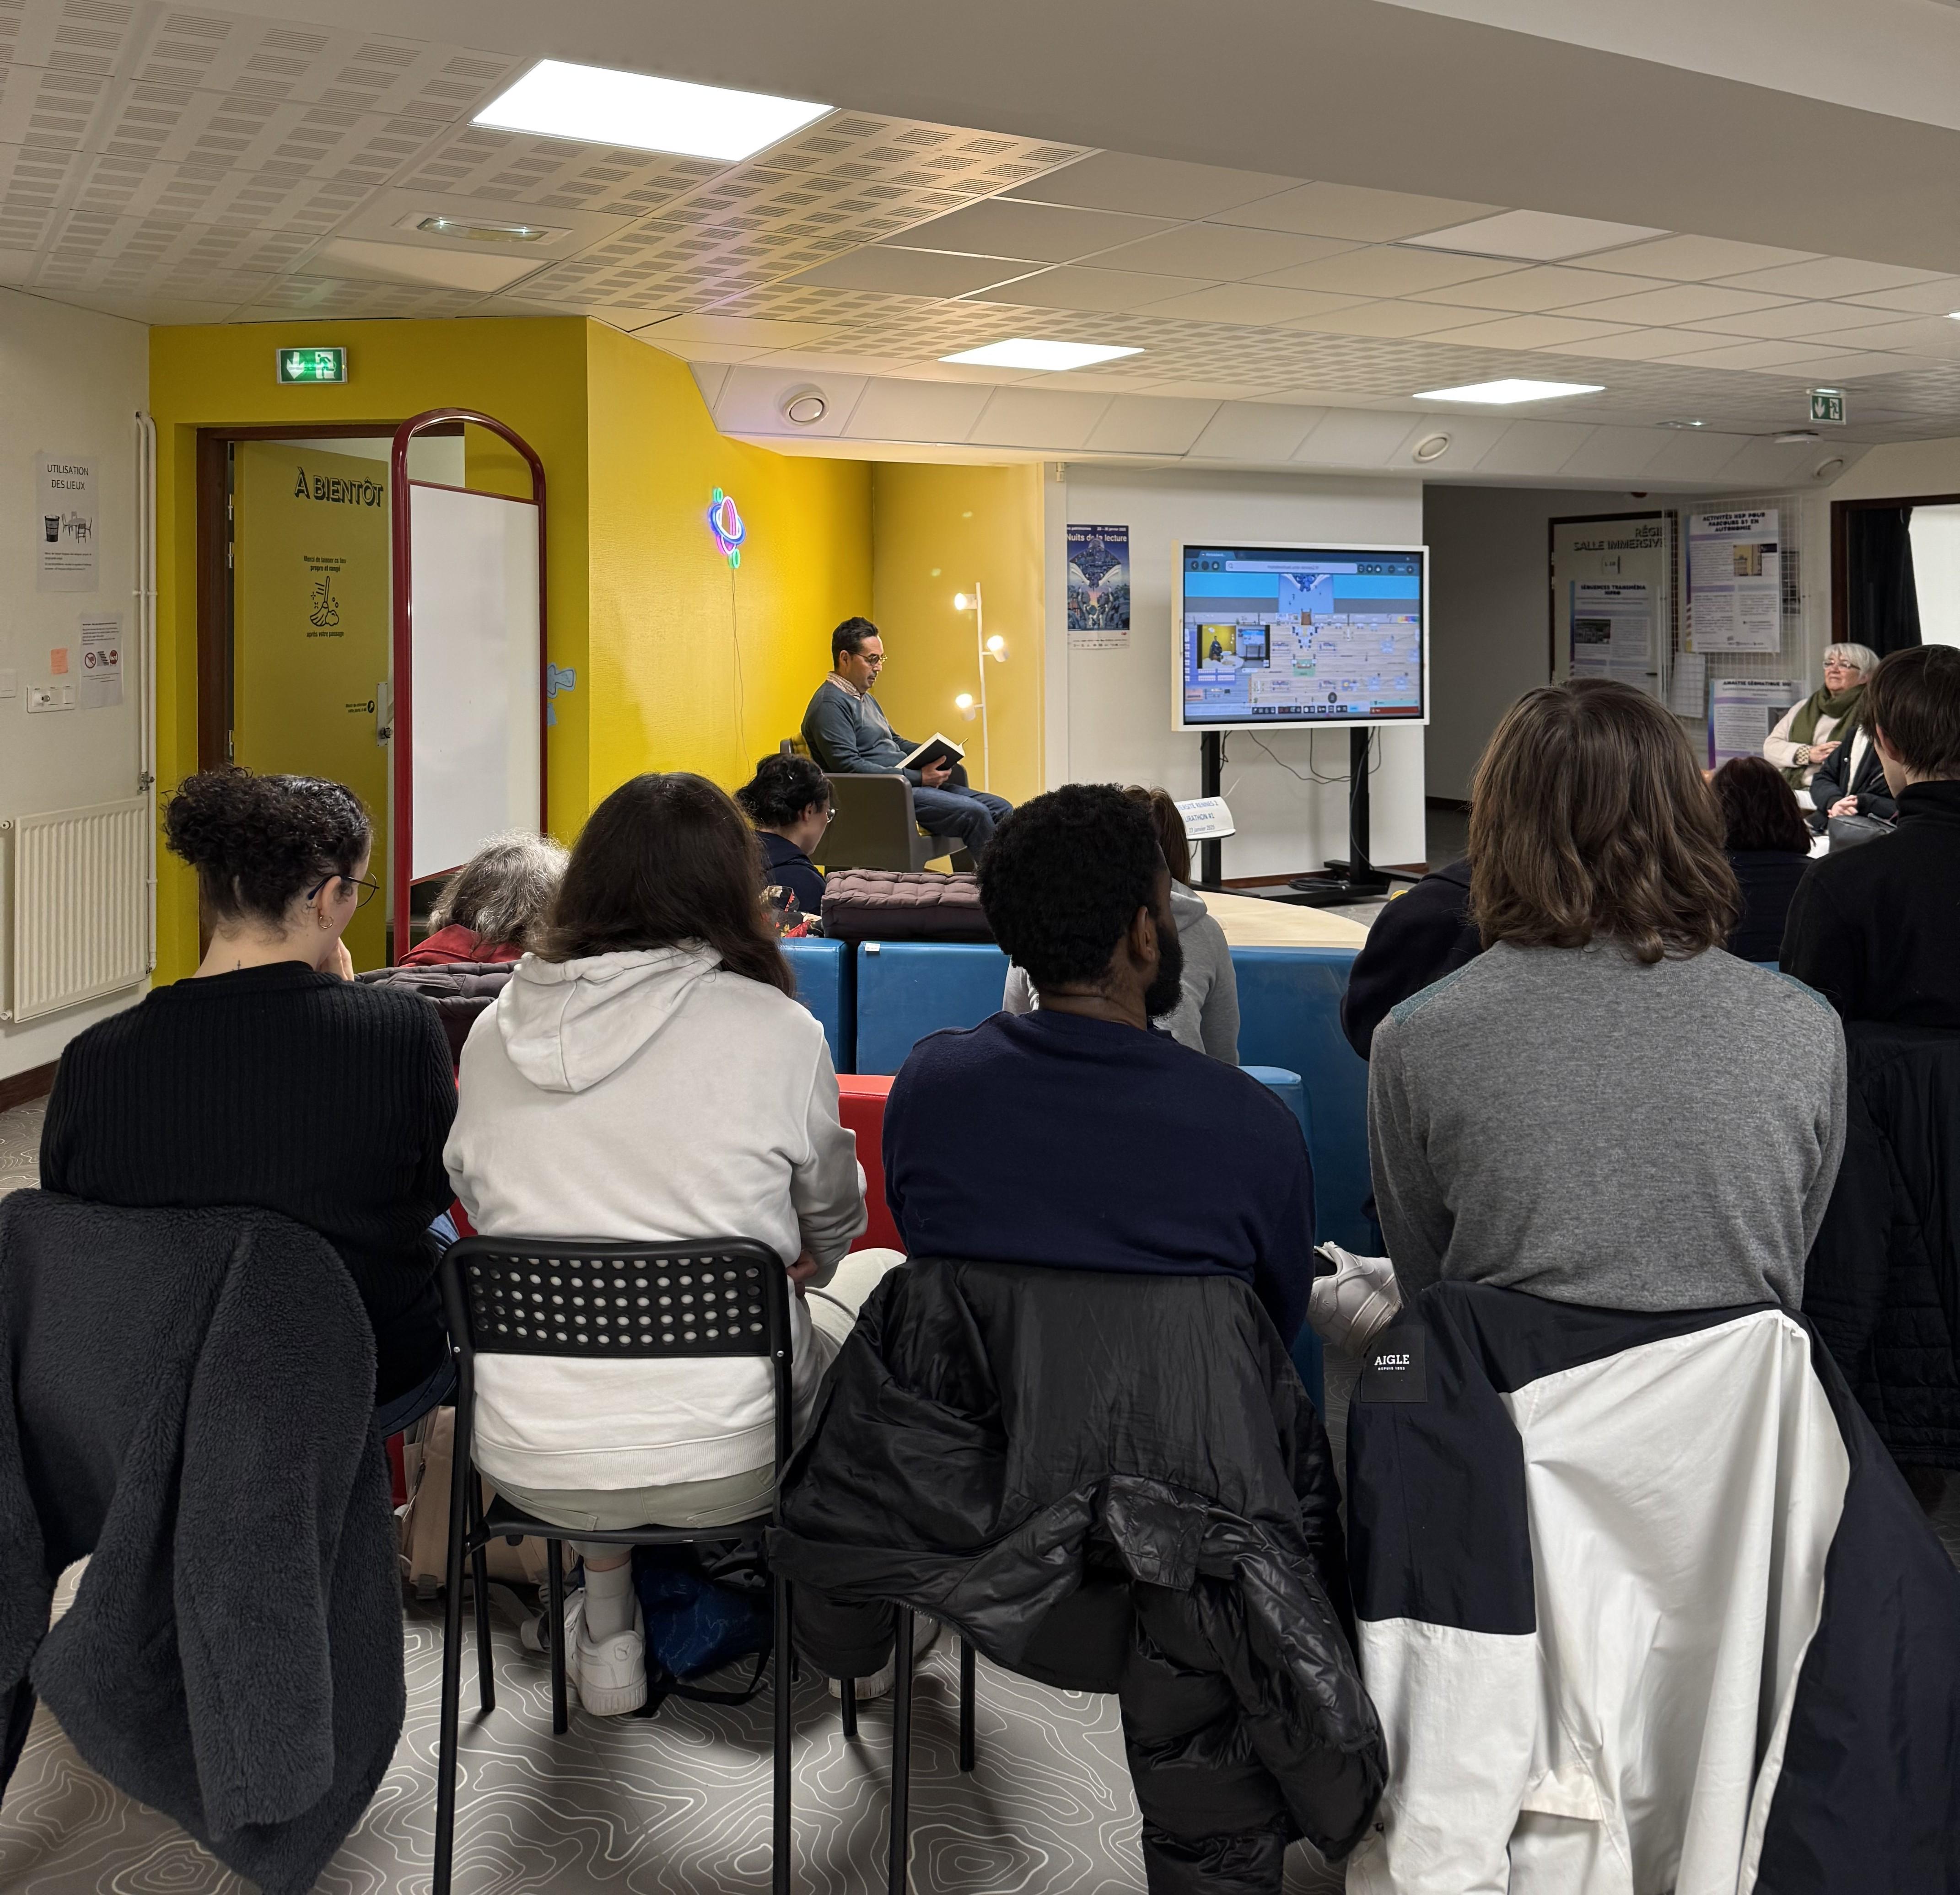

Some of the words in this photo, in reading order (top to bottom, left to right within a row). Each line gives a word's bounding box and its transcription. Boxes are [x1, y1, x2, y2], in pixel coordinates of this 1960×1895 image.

[47, 464, 88, 476] UTILISATION
[51, 479, 65, 488] DES
[66, 481, 85, 490] LIEUX
[295, 466, 310, 499] À
[313, 475, 383, 507] BIENTÔT
[1574, 541, 1605, 551] SALLE
[1374, 1354, 1410, 1366] AIGLE
